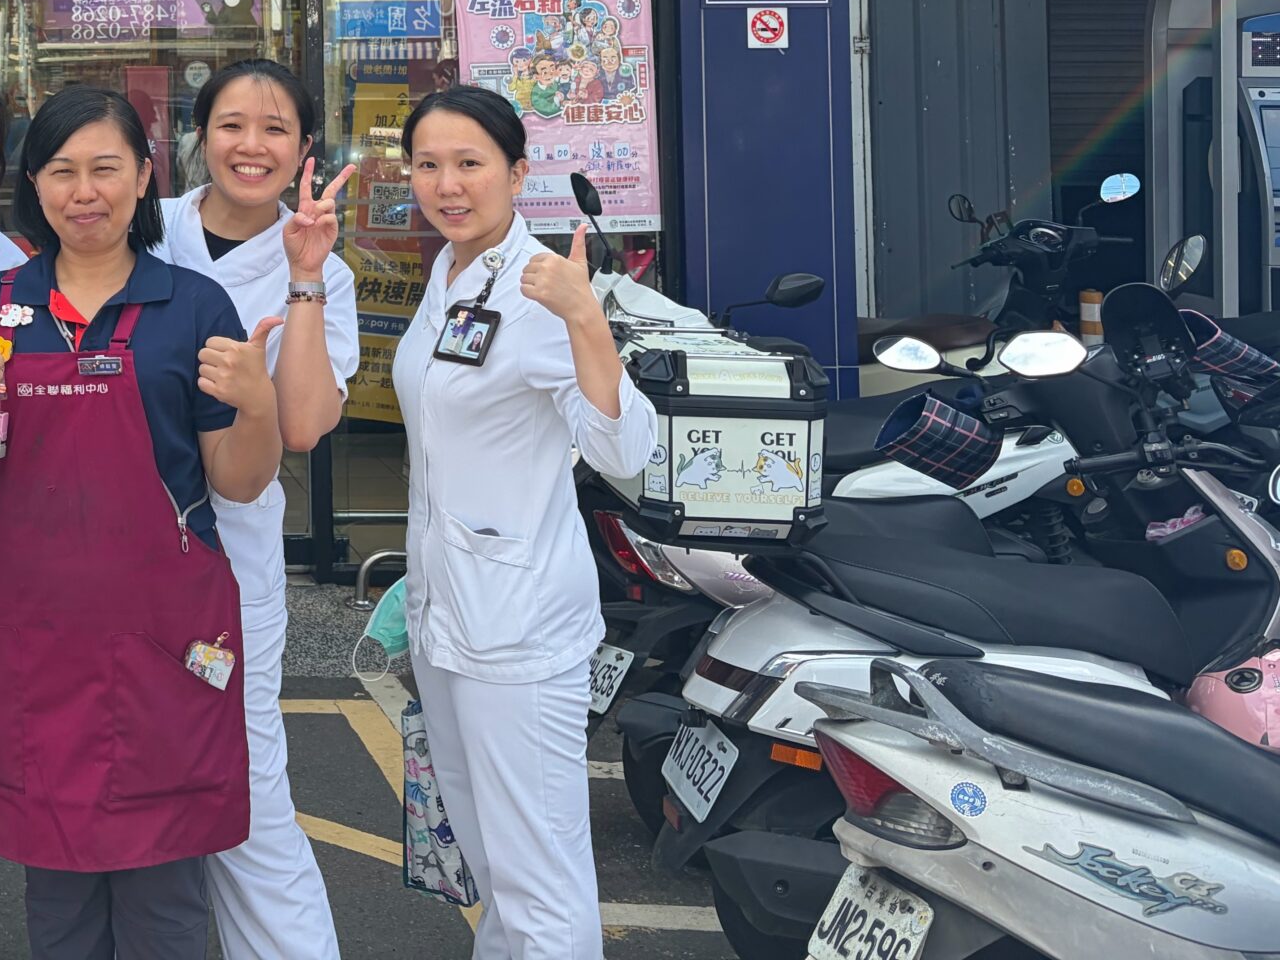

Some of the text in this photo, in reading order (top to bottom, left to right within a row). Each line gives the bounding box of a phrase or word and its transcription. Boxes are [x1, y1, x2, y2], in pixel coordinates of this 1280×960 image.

[563, 103, 645, 123] 健康安心
[34, 382, 109, 396] 全聯福利中心
[686, 429, 723, 445] GET
[760, 431, 797, 447] GET
[679, 491, 731, 503] BELIEVE
